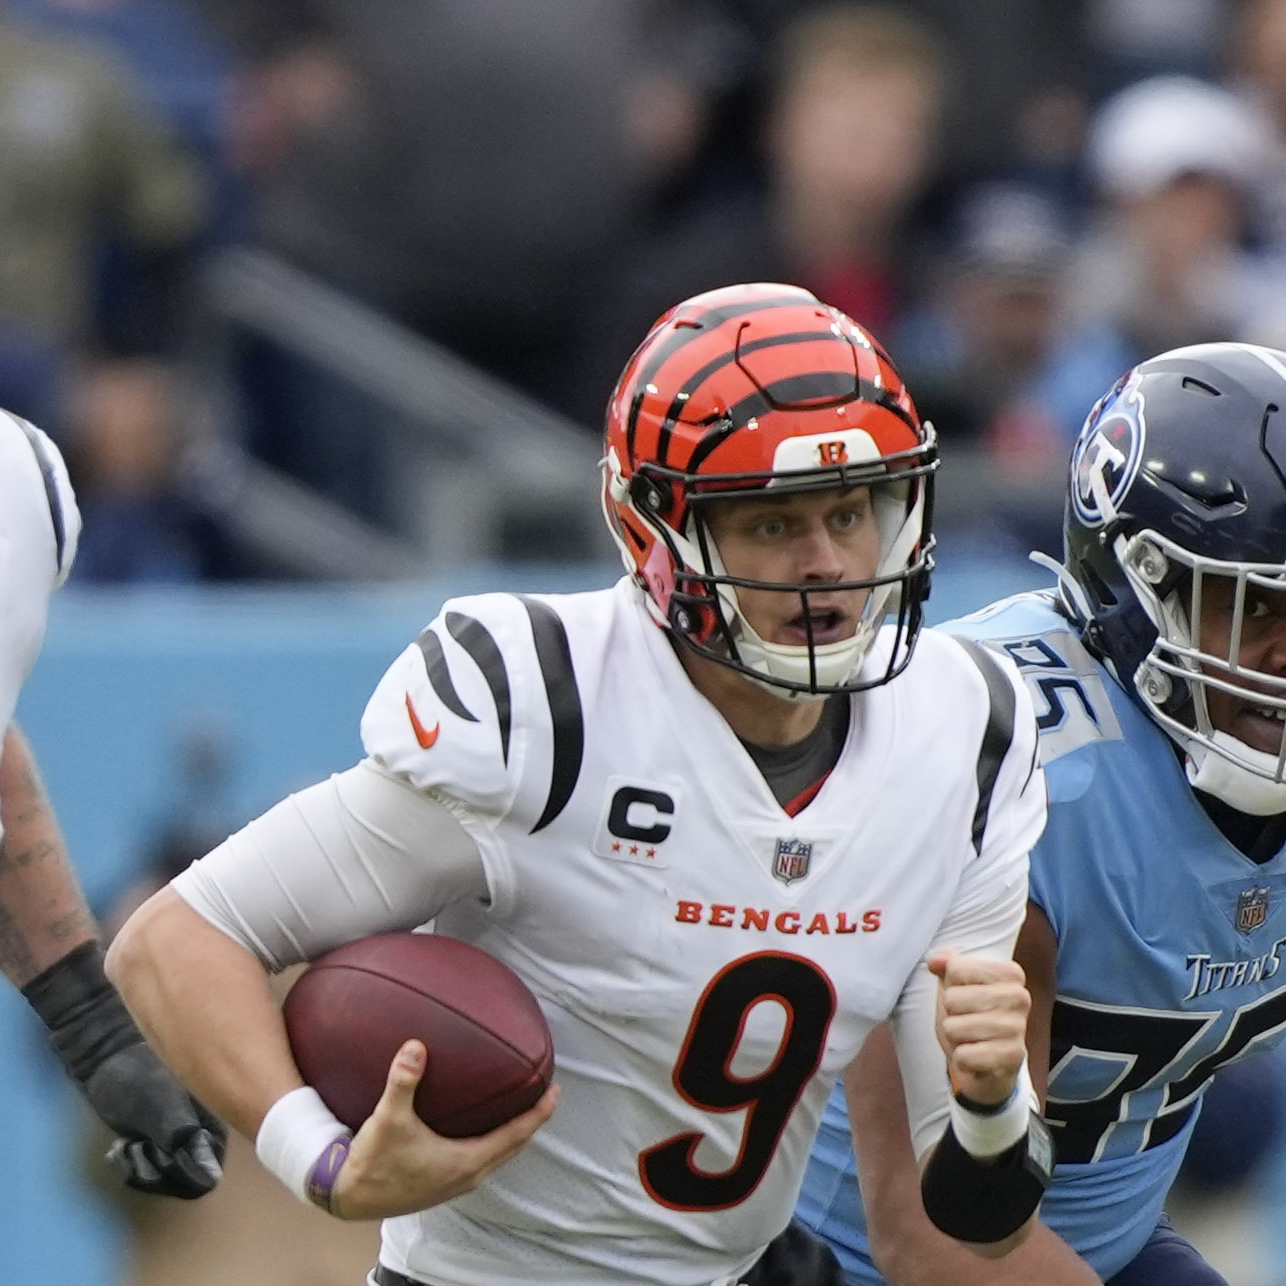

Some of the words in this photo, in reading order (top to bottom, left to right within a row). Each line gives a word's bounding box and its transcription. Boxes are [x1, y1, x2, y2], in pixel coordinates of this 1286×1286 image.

[607, 785, 675, 845] C
[675, 900, 883, 935] BENGALS
[638, 949, 838, 1213] 9
